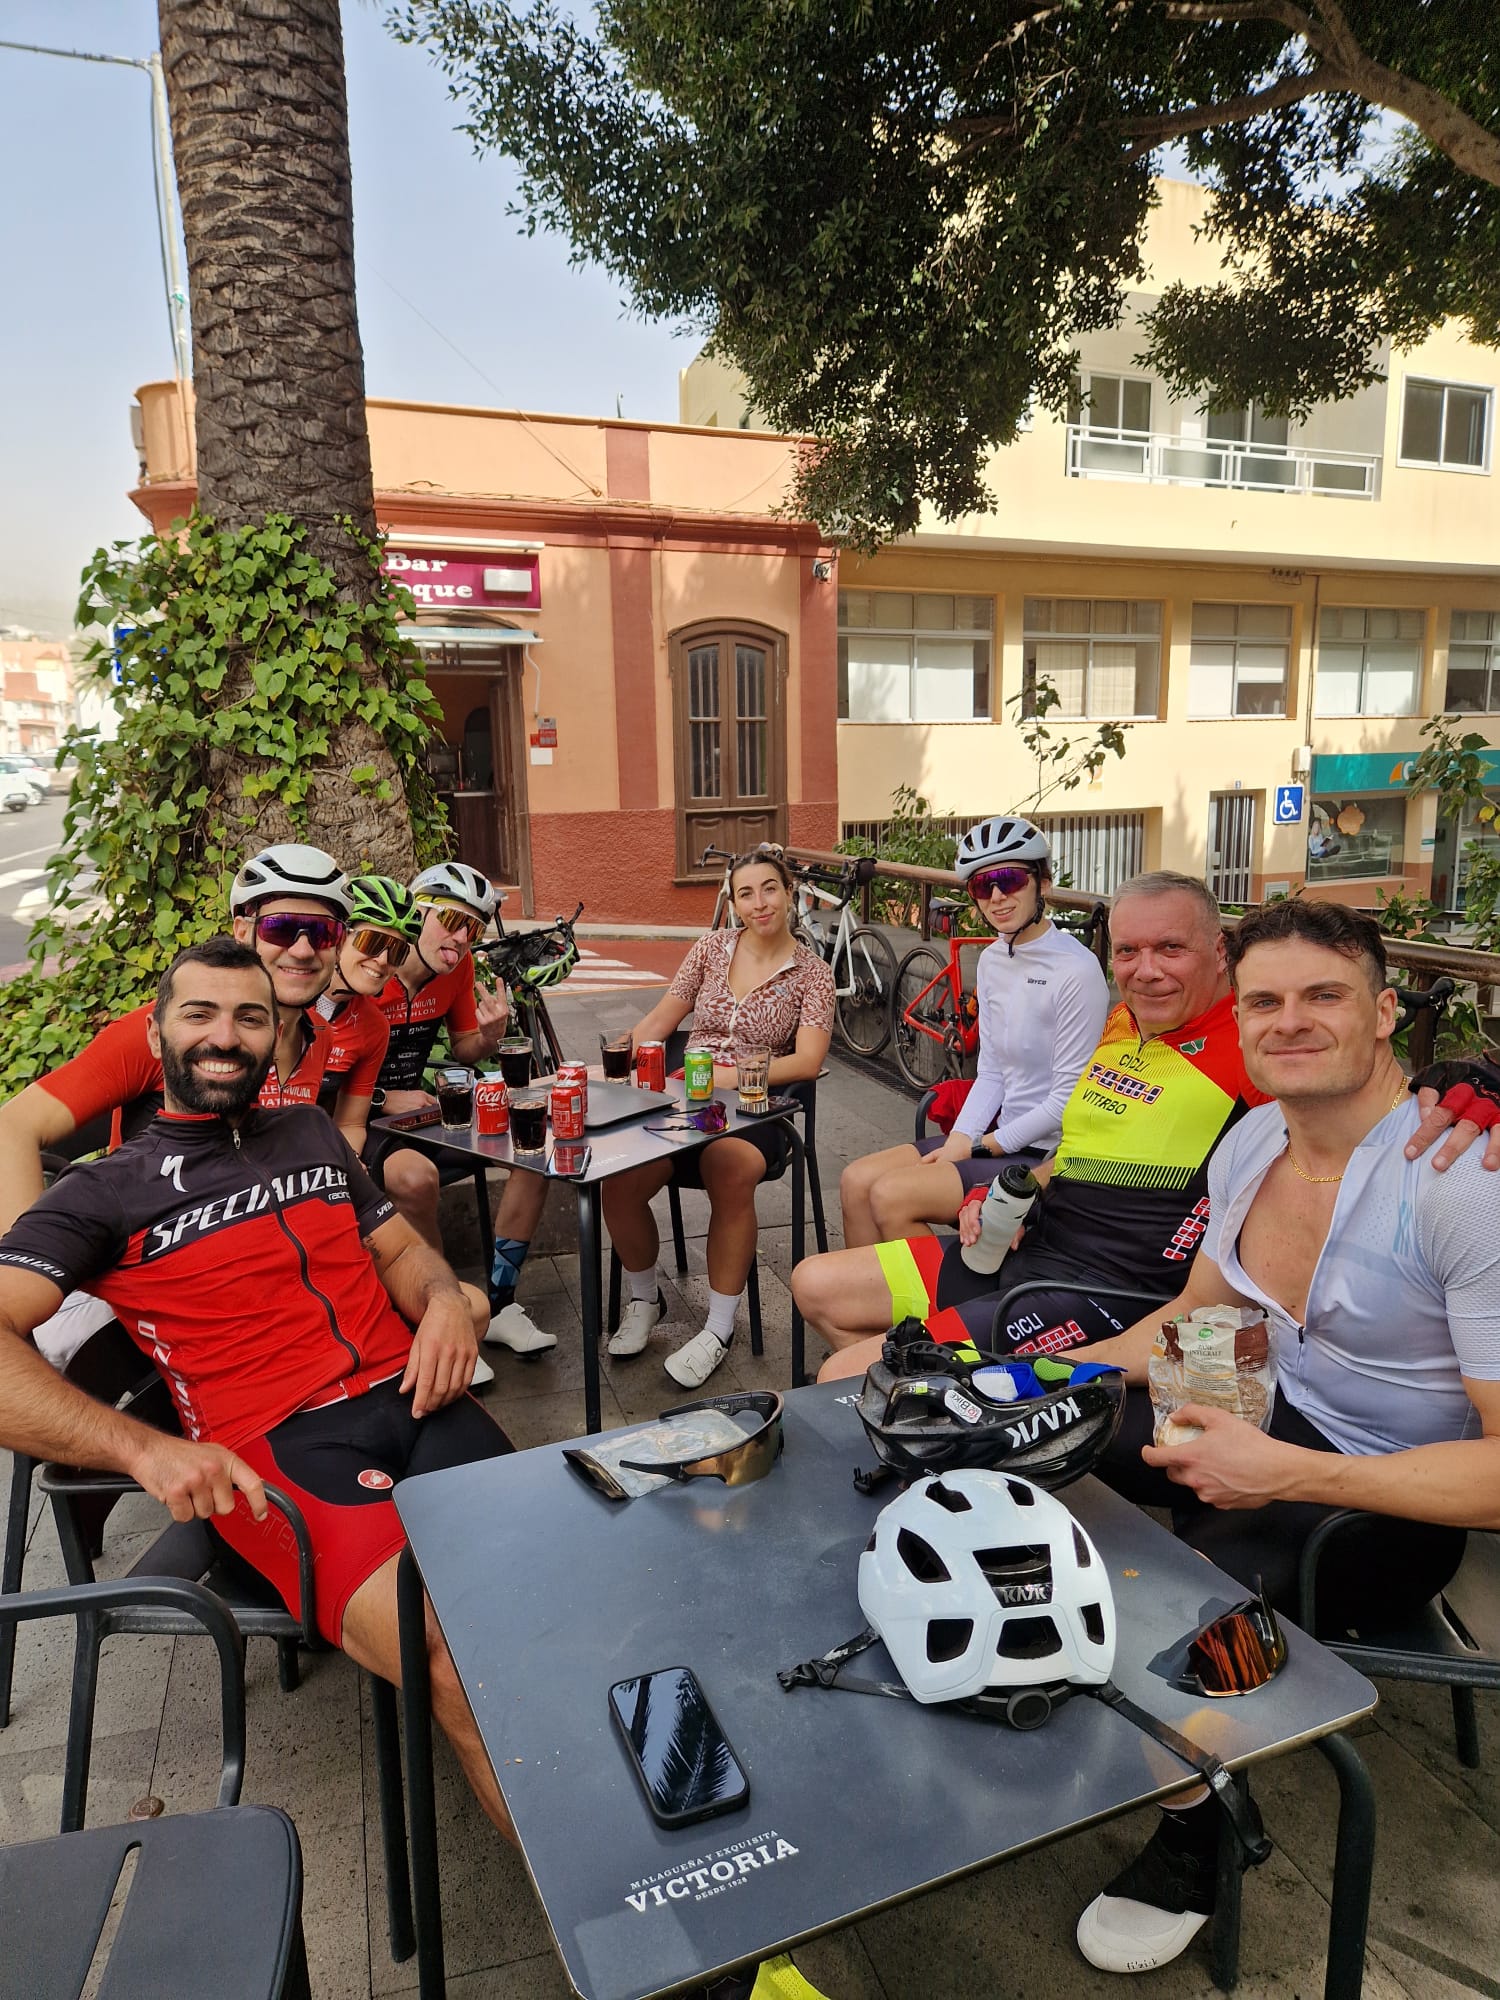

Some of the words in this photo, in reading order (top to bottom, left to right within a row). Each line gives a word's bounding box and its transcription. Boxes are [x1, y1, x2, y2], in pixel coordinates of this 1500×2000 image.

[385, 552, 448, 572] Bar
[386, 1008, 436, 1020] RIATHLON
[1119, 1053, 1151, 1073] CICLI
[1082, 1087, 1128, 1115] VITERBO
[148, 1165, 348, 1257] SPECIALIZED
[1006, 1312, 1045, 1341] CICLI
[1004, 1396, 1082, 1449] KASK
[1001, 1586, 1048, 1604] KASK
[630, 1858, 703, 1890] MALAGUEÑA
[705, 1853, 713, 1863] Y
[716, 1829, 779, 1859] EXQUISITA
[625, 1838, 800, 1913] VICTORIA
[695, 1884, 727, 1902] DESDE
